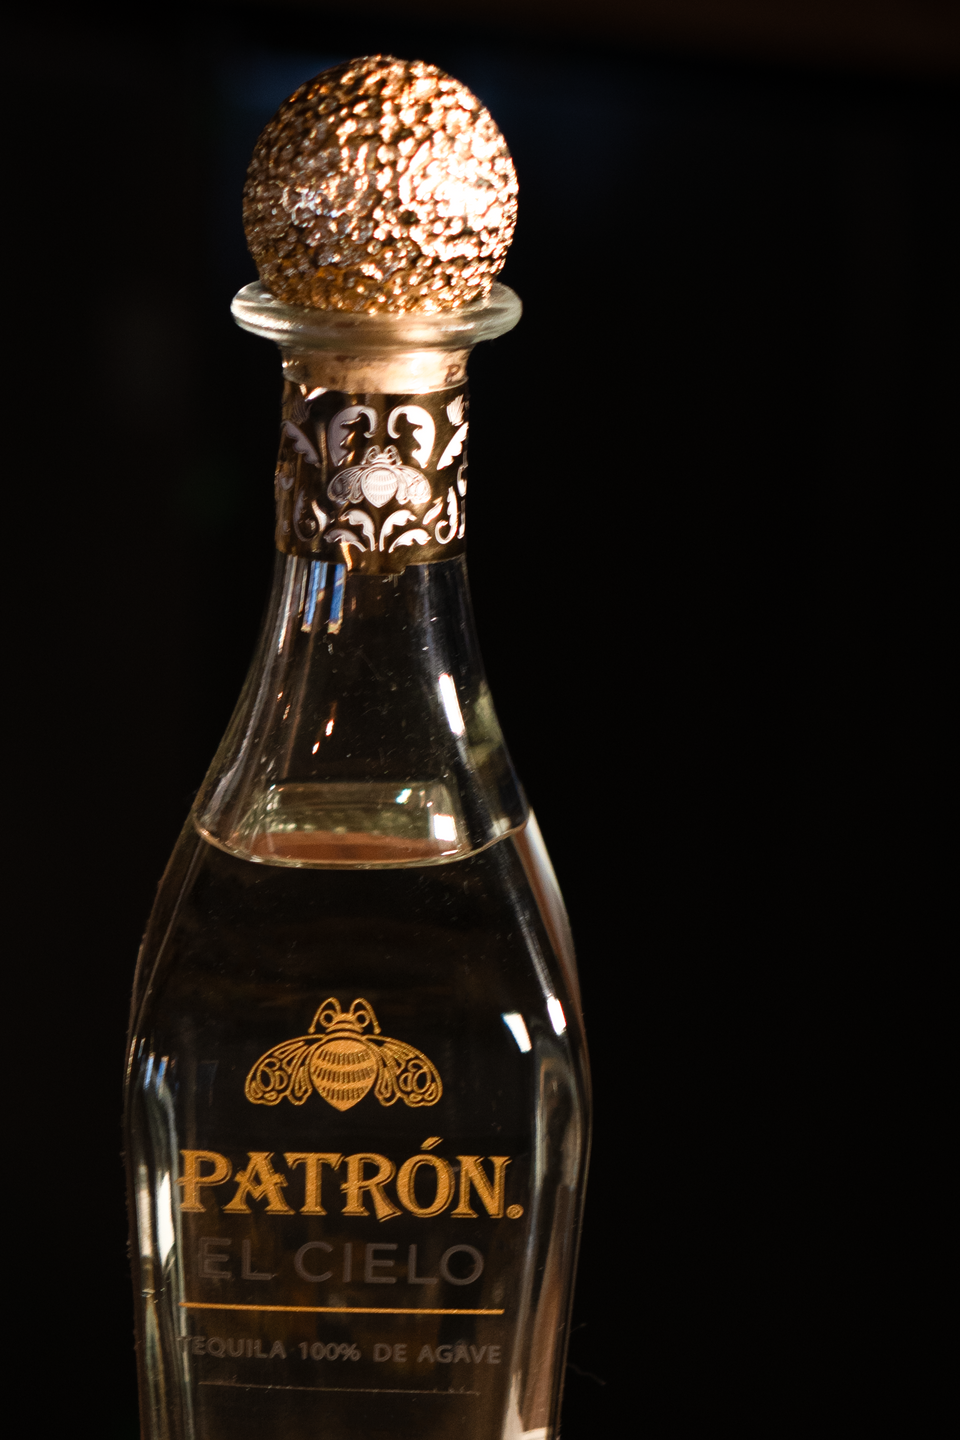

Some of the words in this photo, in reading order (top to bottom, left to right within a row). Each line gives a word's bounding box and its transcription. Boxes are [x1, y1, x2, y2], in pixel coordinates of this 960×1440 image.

[197, 1236, 275, 1281] EL
[293, 1241, 485, 1286] CIELO
[299, 1341, 362, 1362] 100%
[373, 1343, 407, 1363] DE
[417, 1344, 502, 1364] AGAVE
